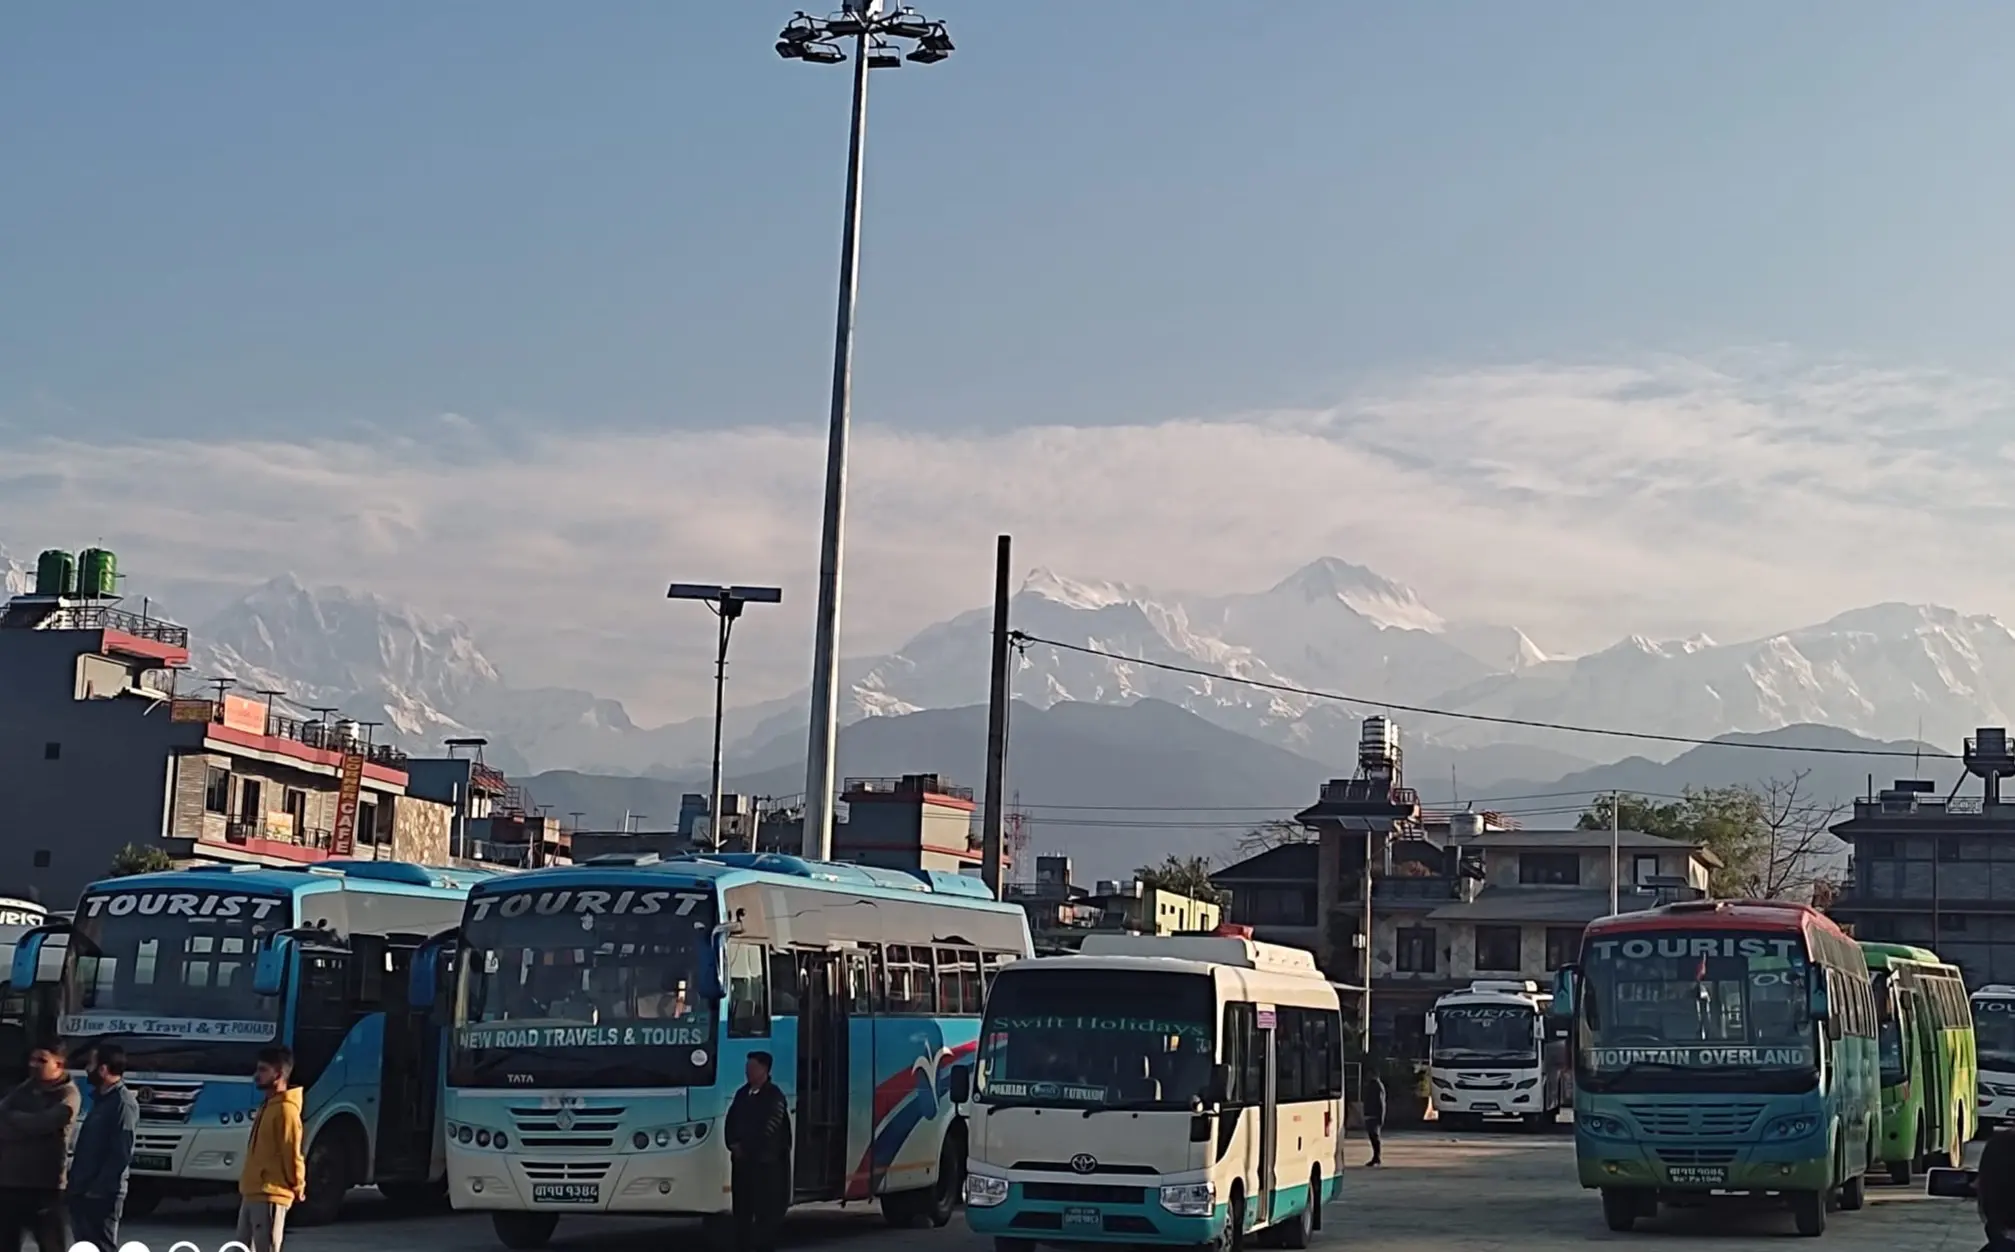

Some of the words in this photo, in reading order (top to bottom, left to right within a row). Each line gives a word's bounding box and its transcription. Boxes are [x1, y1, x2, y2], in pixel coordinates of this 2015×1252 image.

[336, 803, 355, 853] CAFE
[86, 894, 282, 919] TOURIST
[471, 891, 708, 921] TOURIST
[1592, 939, 1797, 960] TOURIST
[1440, 1008, 1530, 1019] TOURIST
[107, 1019, 136, 1033] Sky
[142, 1019, 191, 1034] Travel
[196, 1022, 211, 1034] &
[231, 1021, 274, 1035] POKHARA
[993, 1017, 1062, 1029] Swift
[1077, 1017, 1204, 1035] Holidays
[460, 1031, 491, 1048] NEW
[496, 1030, 538, 1047] ROAD
[544, 1028, 618, 1046] TRAVELS
[623, 1028, 636, 1045] &
[642, 1028, 703, 1044] TOURS
[1591, 1051, 1690, 1065] MOUNTAIN
[1699, 1050, 1804, 1065] OVERLAND
[507, 1074, 534, 1083] TATA
[989, 1084, 1027, 1096] POKHARA
